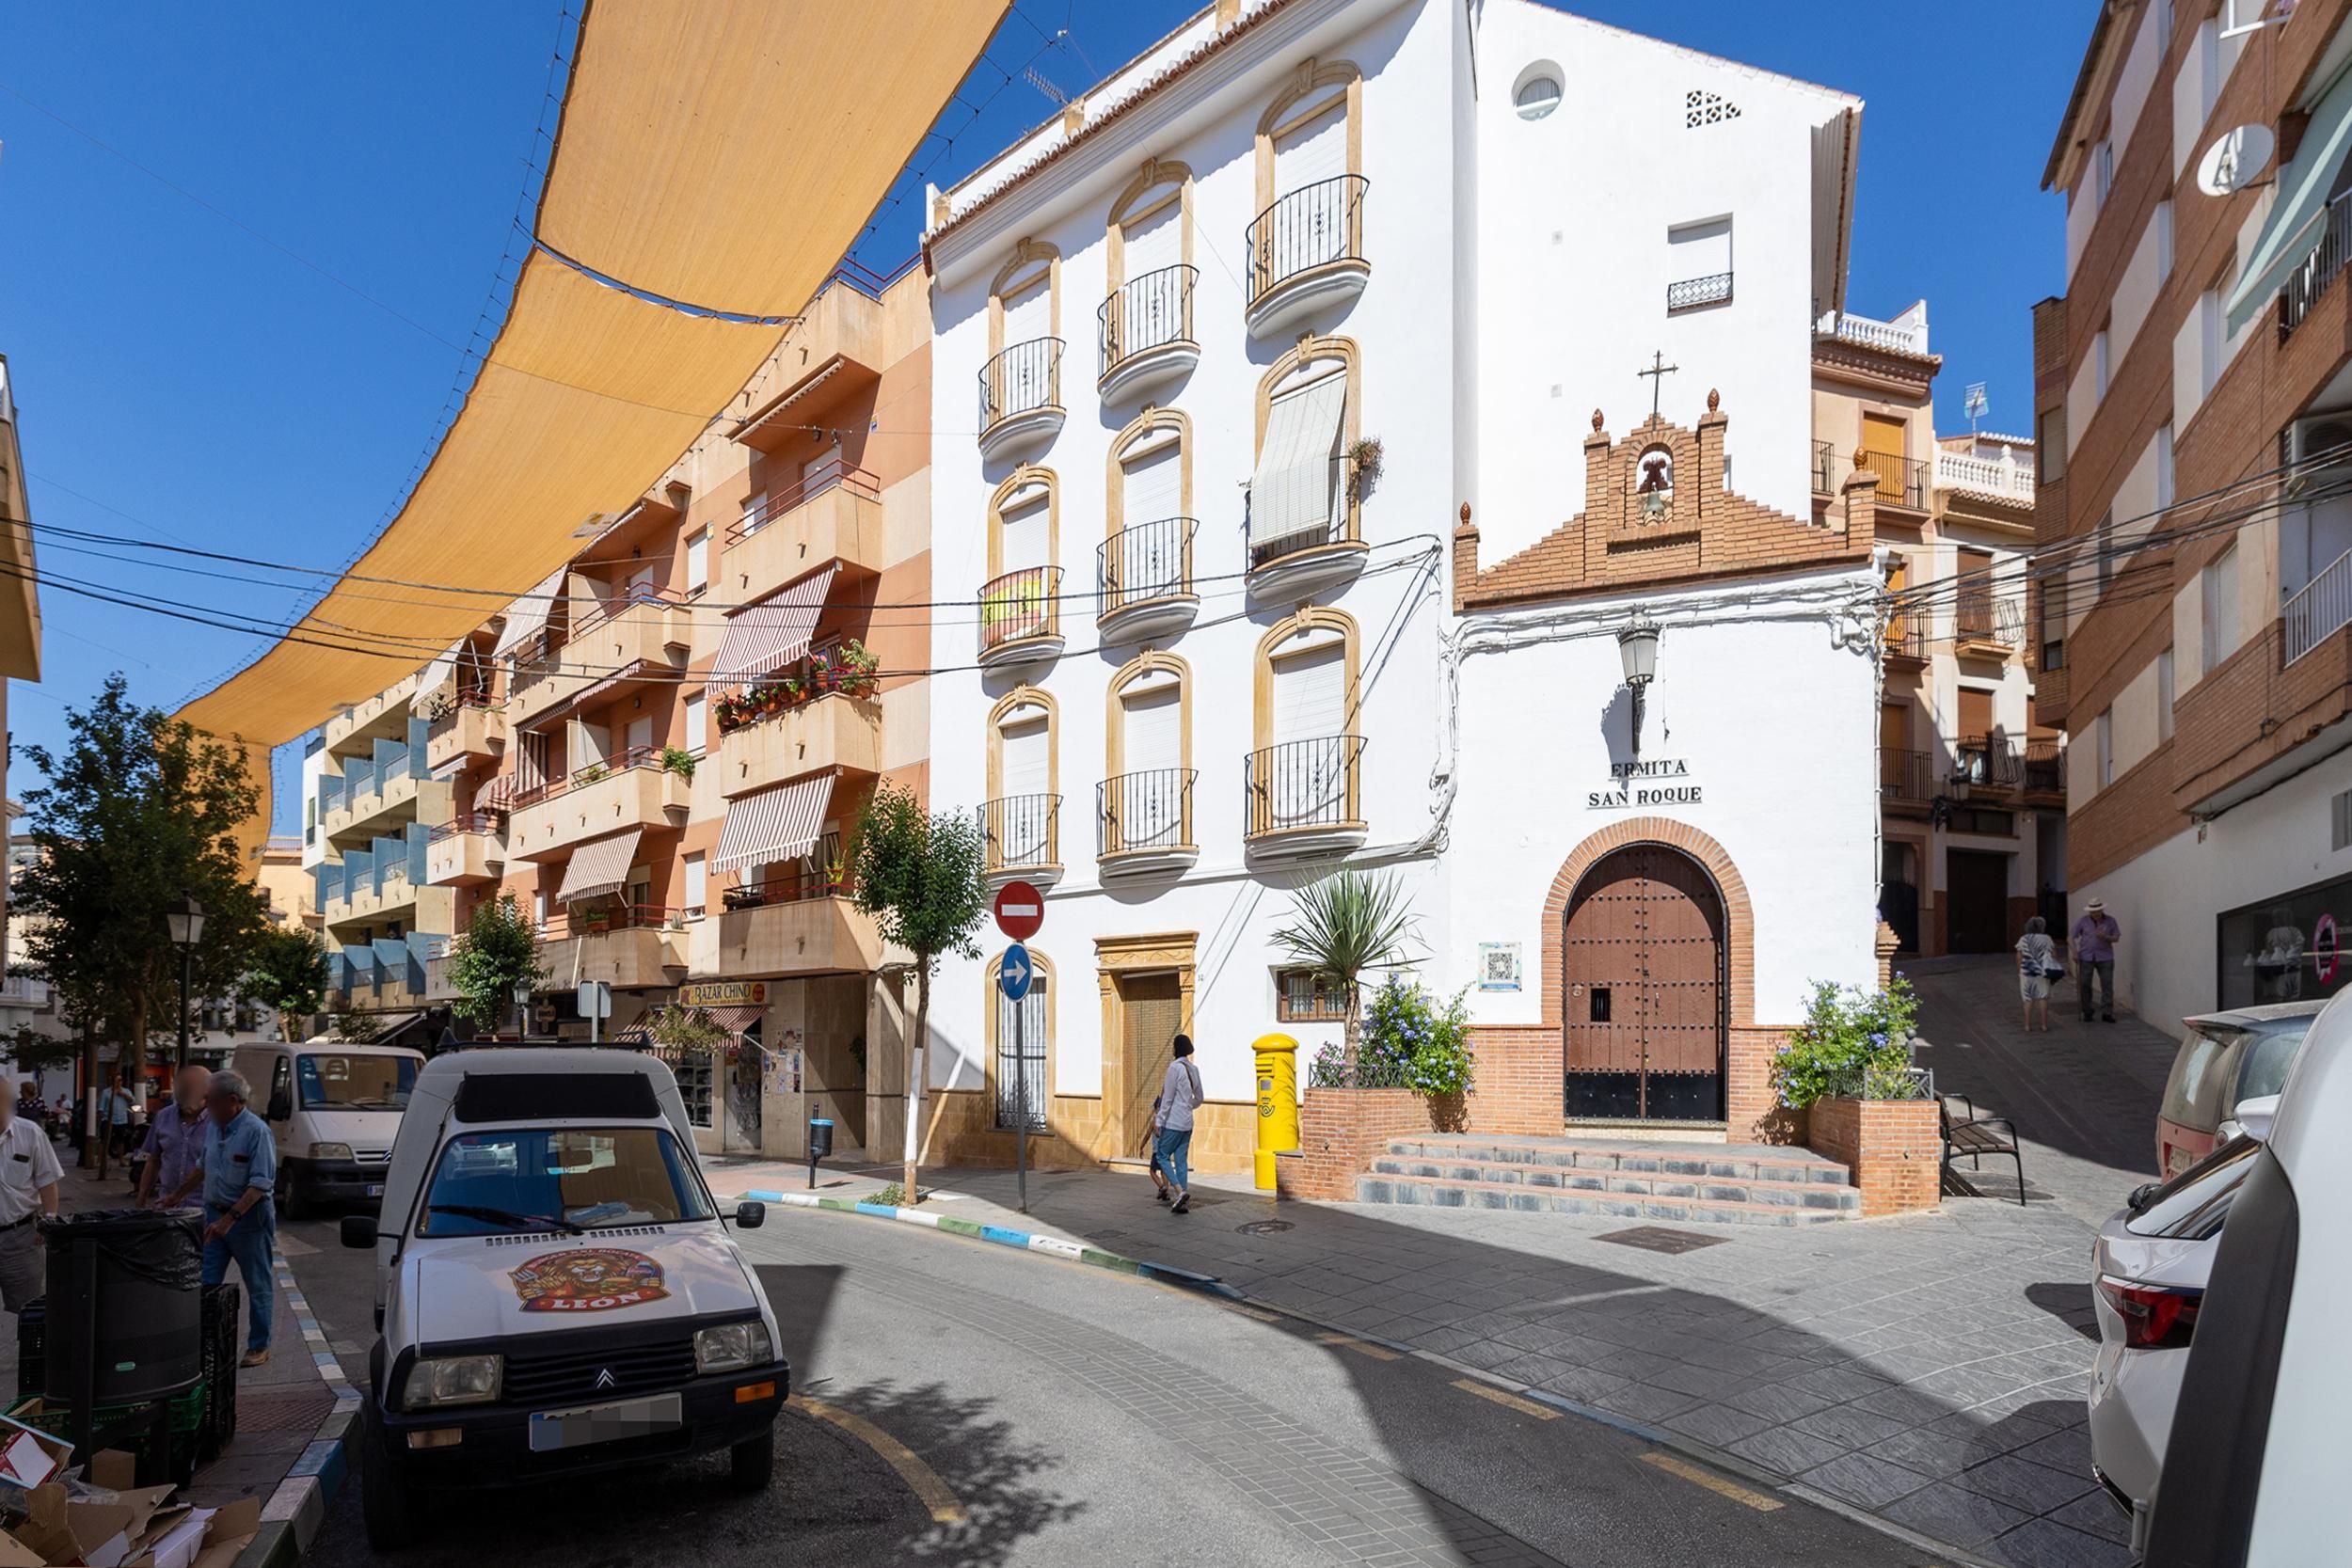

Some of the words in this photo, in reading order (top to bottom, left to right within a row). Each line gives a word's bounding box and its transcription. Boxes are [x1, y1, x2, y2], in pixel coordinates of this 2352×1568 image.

[1611, 759, 1687, 777] ERMITA
[1588, 791, 1629, 806] SAN
[1637, 786, 1702, 804] ROQUE
[695, 985, 723, 1006] BAZAR
[723, 983, 751, 1000] CHINO
[551, 1291, 642, 1309] LEÓN
